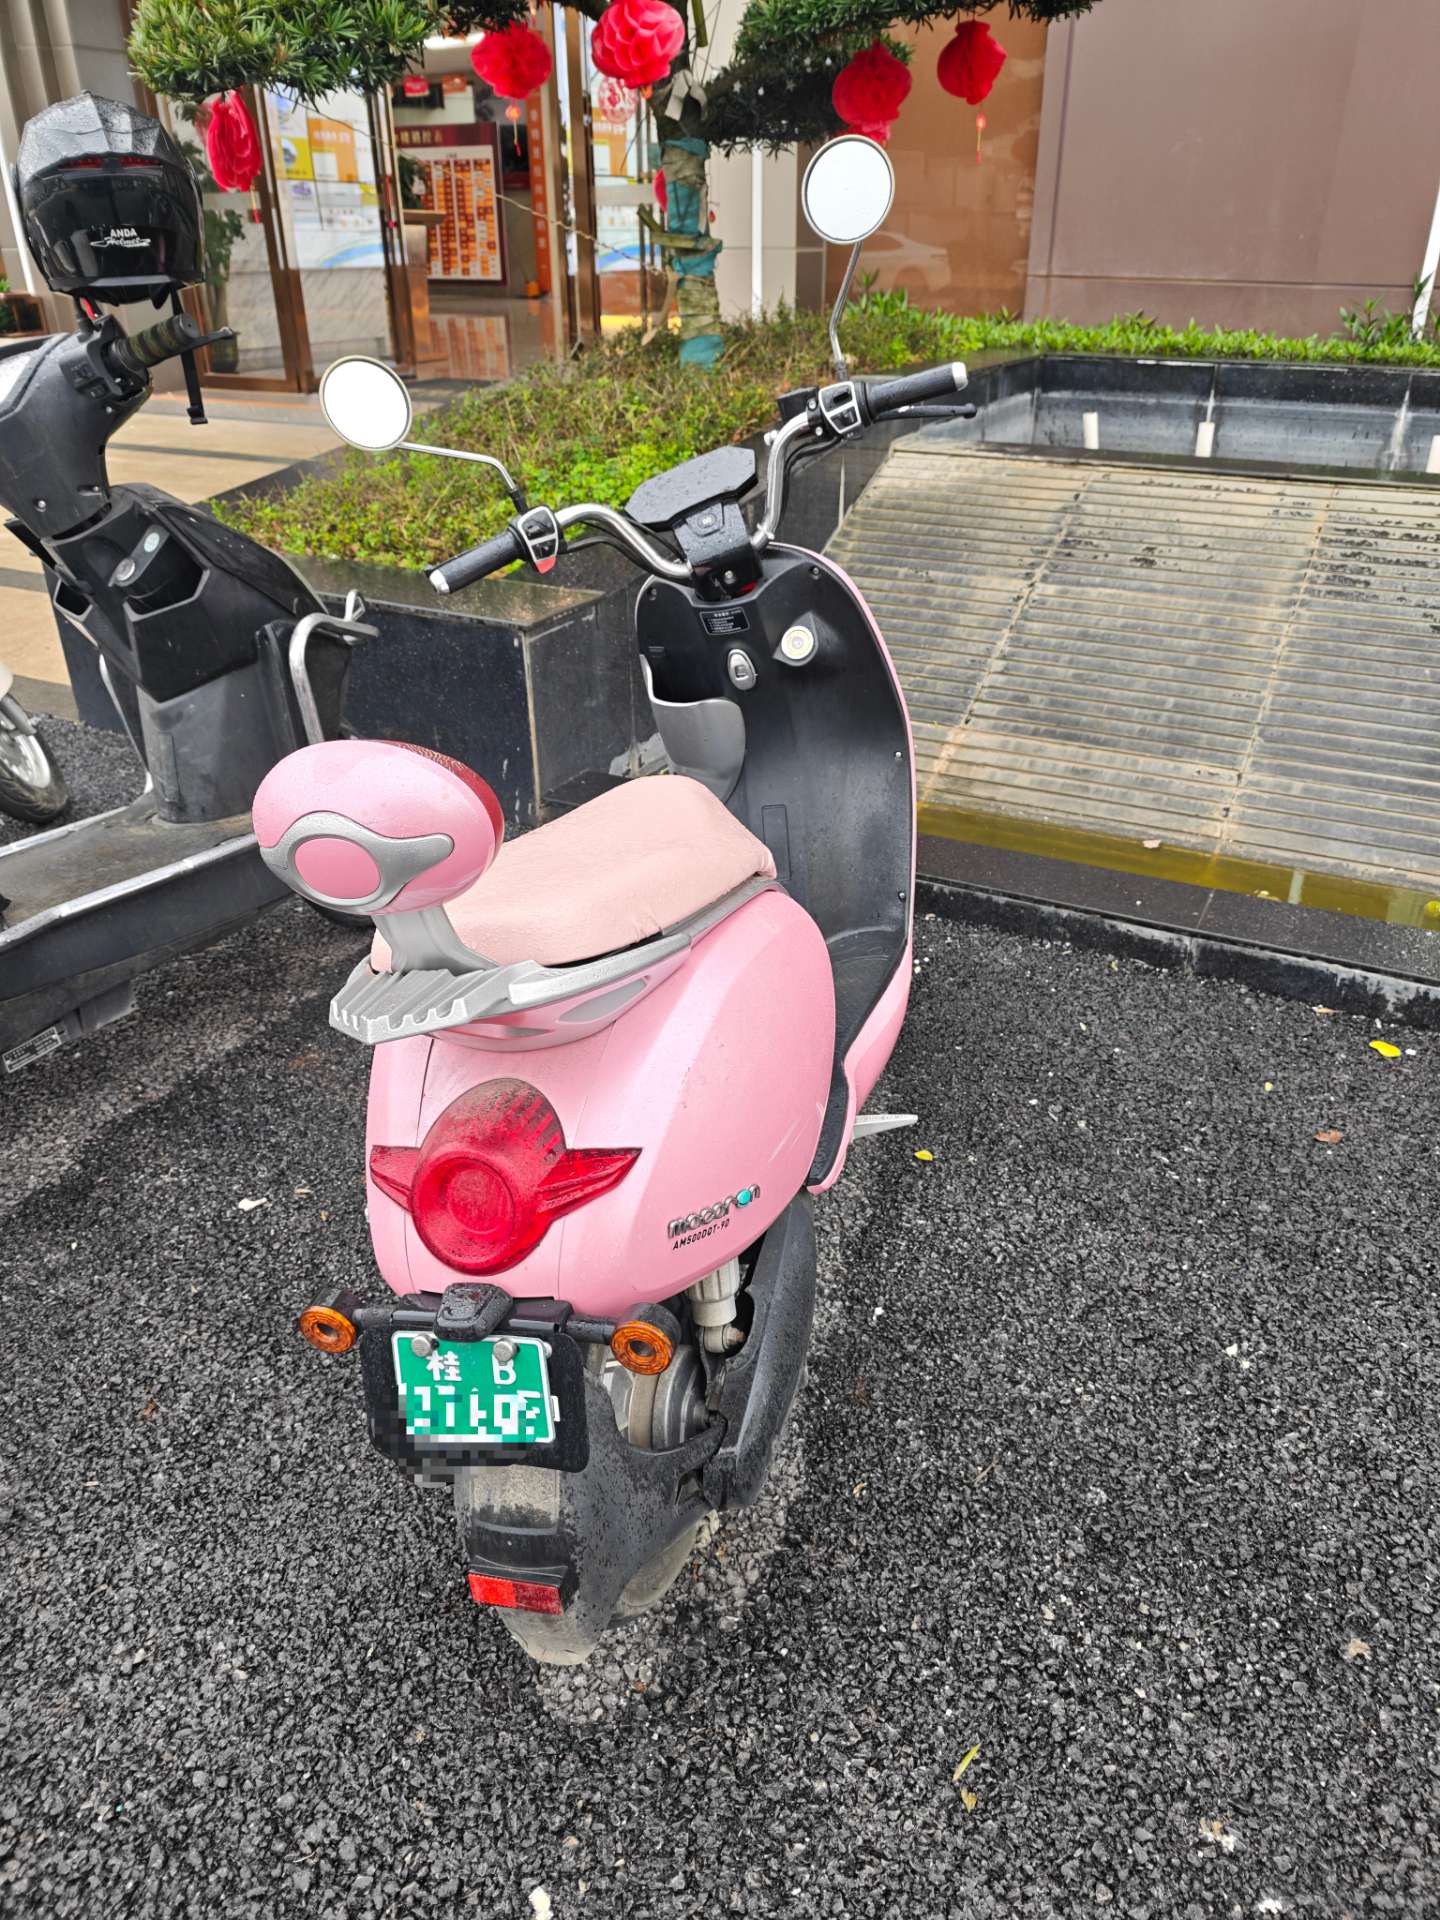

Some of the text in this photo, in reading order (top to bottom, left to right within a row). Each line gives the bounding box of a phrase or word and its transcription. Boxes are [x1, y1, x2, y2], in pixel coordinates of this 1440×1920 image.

[110, 227, 138, 237] ANDA
[426, 1347, 517, 1385] 桂 B
